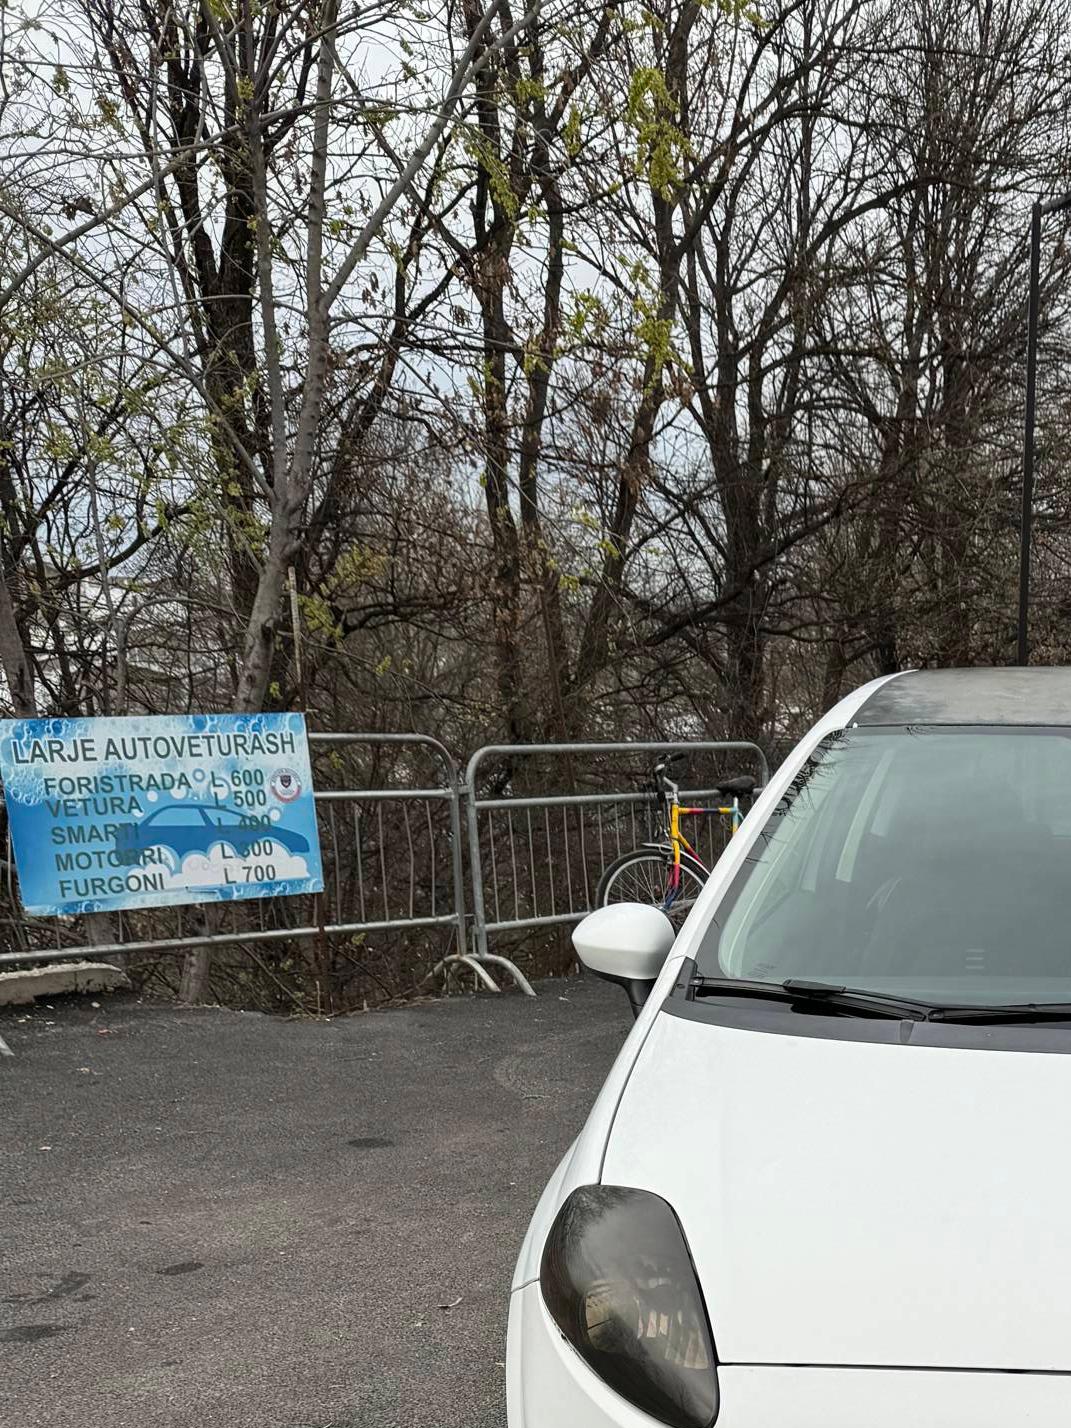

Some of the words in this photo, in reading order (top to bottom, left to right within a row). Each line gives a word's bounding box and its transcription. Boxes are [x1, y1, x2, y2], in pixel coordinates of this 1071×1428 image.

[12, 739, 98, 764] LARJE
[104, 732, 295, 761] AUTOVETURASH
[44, 772, 192, 796] FORISTRADA
[211, 771, 224, 787] L
[231, 769, 264, 787] 600
[45, 796, 143, 818] VETURA
[234, 790, 267, 807] 500
[220, 842, 234, 859] L
[59, 873, 165, 898] FURGONI
[224, 868, 237, 884] L
[242, 864, 276, 882] 700
